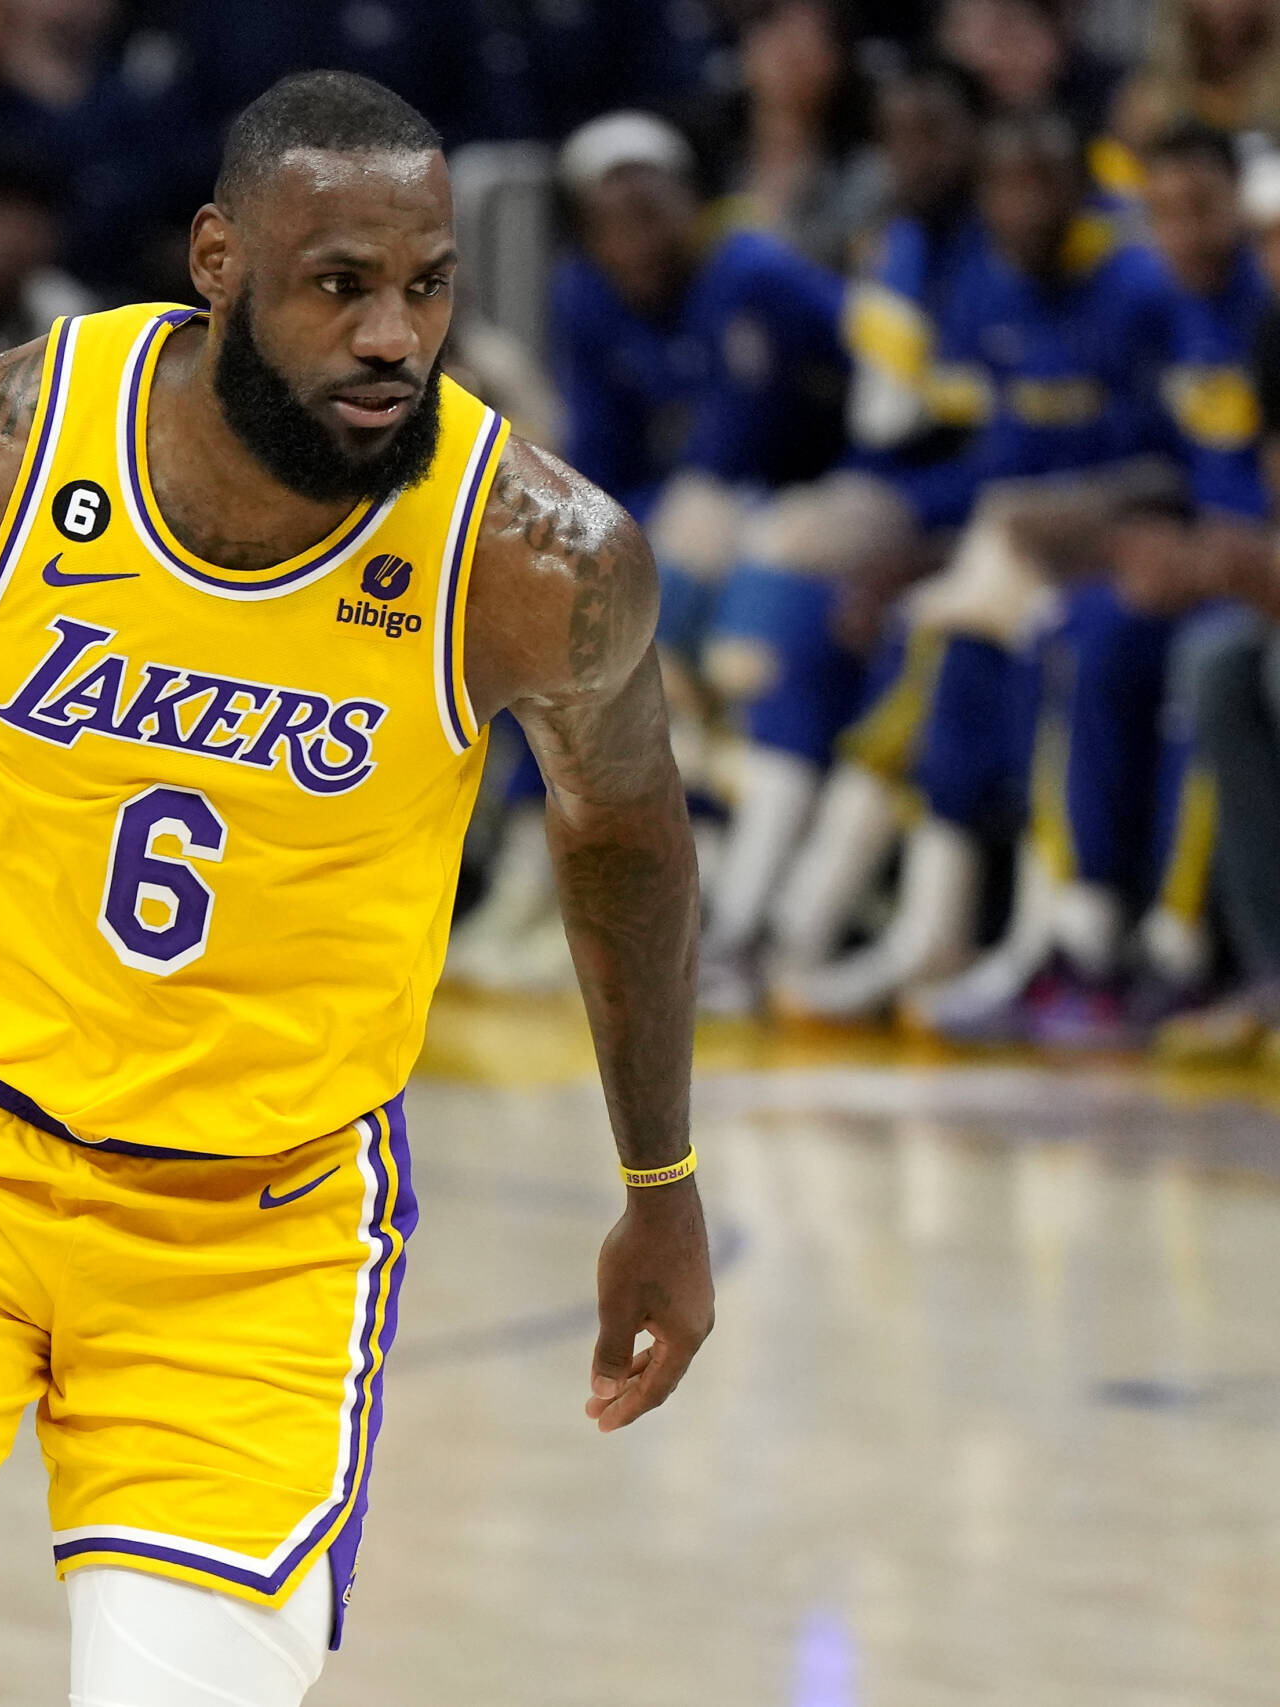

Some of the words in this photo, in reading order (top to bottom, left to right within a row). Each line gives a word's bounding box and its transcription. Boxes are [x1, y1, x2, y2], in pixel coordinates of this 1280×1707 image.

[64, 488, 100, 535] 6
[336, 598, 422, 638] bibigo
[97, 782, 228, 976] 6
[626, 1166, 684, 1184] PROMISE
